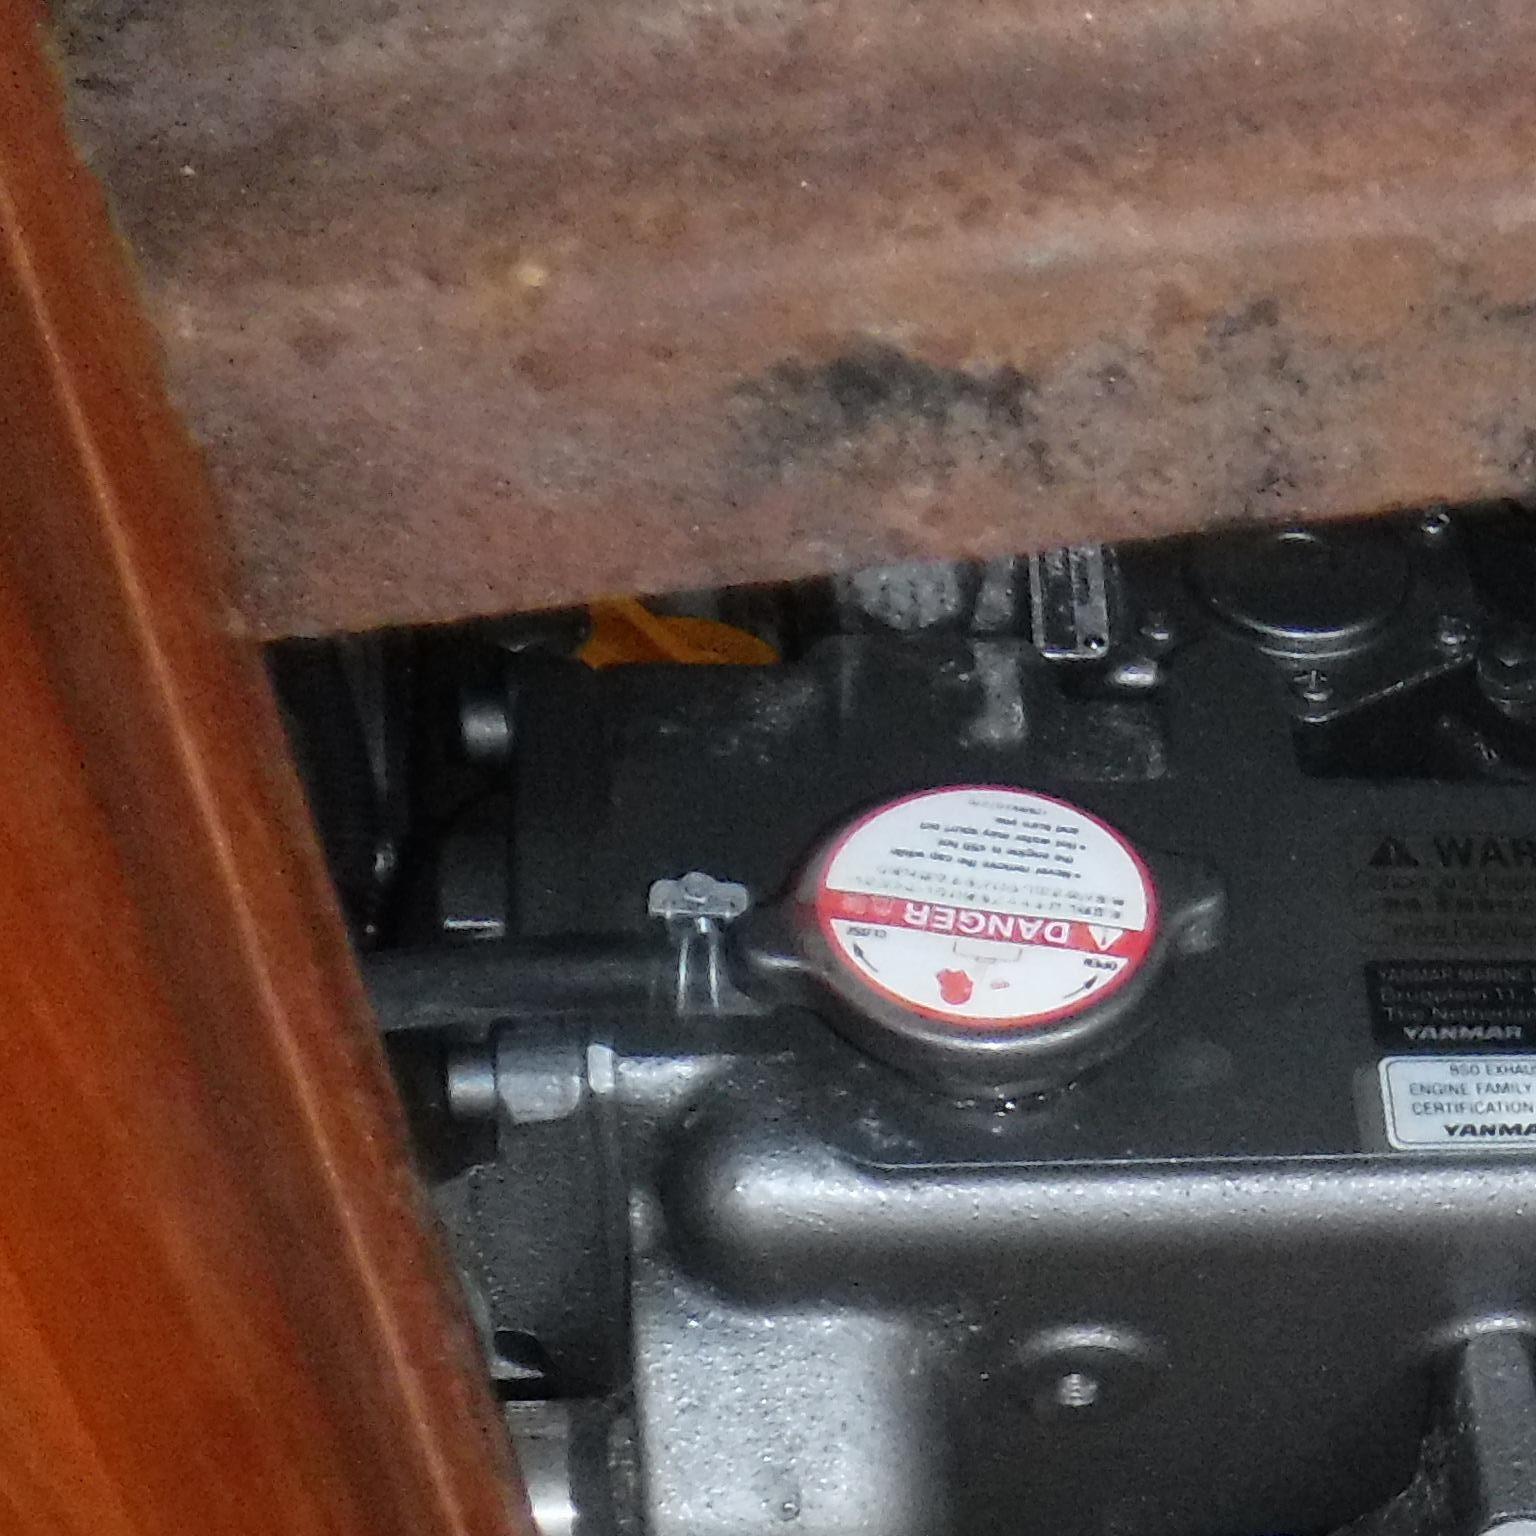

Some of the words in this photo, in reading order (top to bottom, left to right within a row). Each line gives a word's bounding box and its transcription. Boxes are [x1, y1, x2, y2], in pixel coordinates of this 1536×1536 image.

[903, 902, 1070, 944] DANGER
[1402, 1025, 1523, 1041] YANMAR
[1409, 1082, 1469, 1096] ENGINE
[1475, 1082, 1532, 1096] FAMILY
[1411, 1101, 1535, 1116] CERTIFICATION
